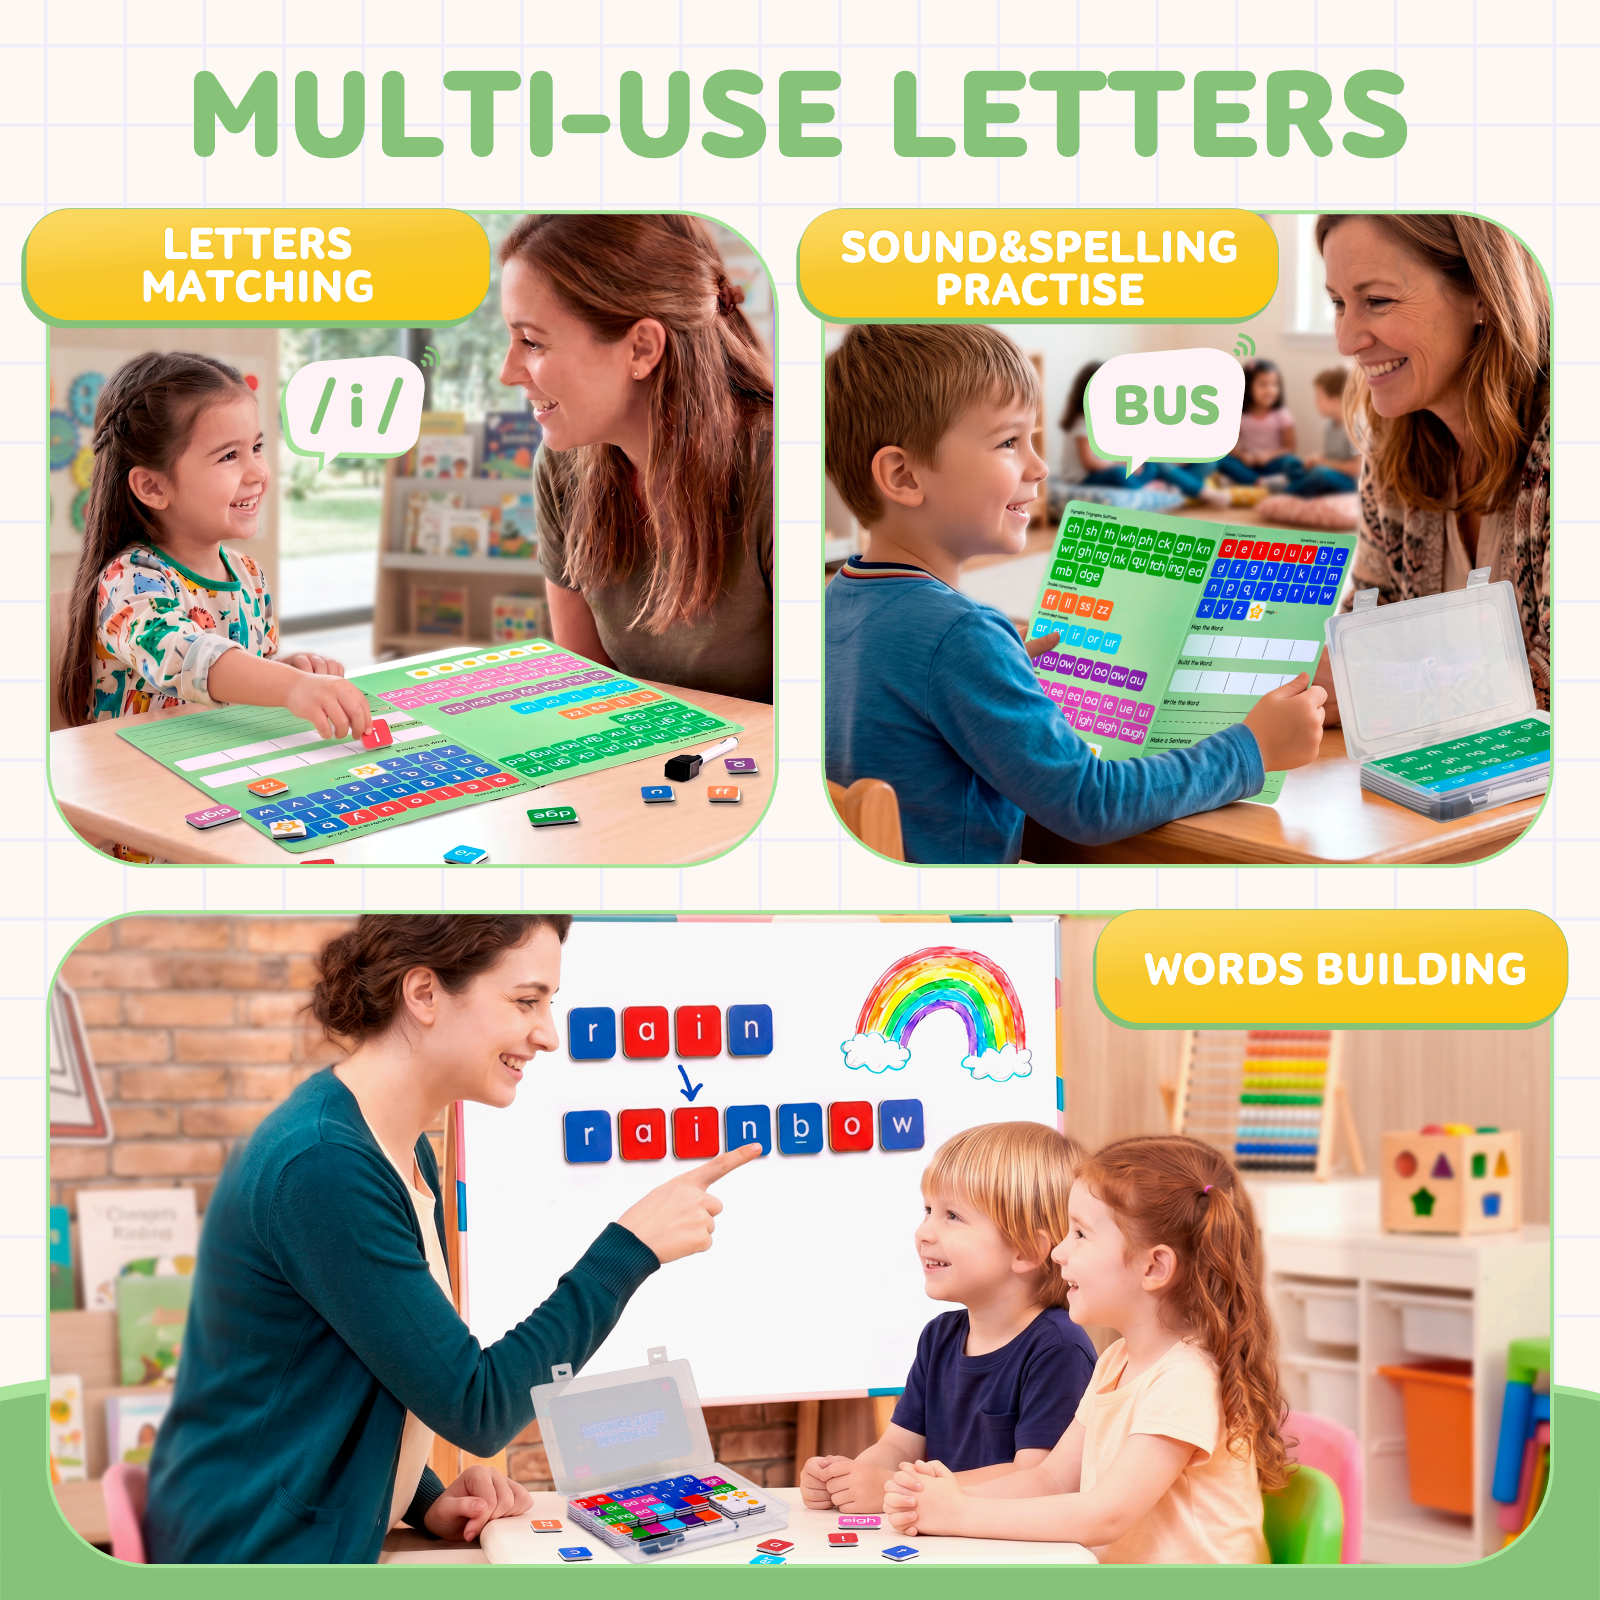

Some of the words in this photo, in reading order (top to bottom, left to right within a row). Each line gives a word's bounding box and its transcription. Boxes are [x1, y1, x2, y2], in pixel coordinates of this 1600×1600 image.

[1068, 522, 1080, 534] ch
[1085, 526, 1098, 536] sh
[1104, 528, 1115, 540] th
[1120, 532, 1136, 542] wh
[1138, 534, 1153, 547] ph
[1158, 538, 1171, 549] ck
[1176, 542, 1192, 553] gn
[1196, 542, 1210, 555] kn
[1061, 544, 1074, 554] wr
[1078, 547, 1092, 558] gh
[1095, 551, 1110, 563] ng
[1112, 554, 1126, 564] nk
[1132, 555, 1146, 569] qu
[1150, 559, 1165, 572] tch
[1168, 562, 1184, 577] ing
[1188, 567, 1204, 577] ed
[1259, 544, 1264, 554] i
[1304, 551, 1312, 562] y
[1320, 550, 1327, 560] b
[1056, 566, 1072, 576] mb
[1079, 568, 1100, 583] dge
[1218, 563, 1226, 572] d
[1235, 564, 1241, 573] f
[1250, 565, 1258, 576] g
[1266, 566, 1273, 576] h
[1283, 566, 1290, 579] j
[1298, 569, 1305, 578] k
[1226, 584, 1234, 595] p
[1244, 585, 1251, 596] q
[1294, 589, 1298, 597] t
[1046, 594, 1056, 605] ff
[1080, 602, 1091, 611] ss
[1097, 605, 1109, 615] zz
[1218, 604, 1228, 615] y
[1252, 608, 1260, 616] e
[1036, 624, 1048, 632] ar
[1072, 629, 1080, 640] ir
[1087, 635, 1100, 644] or
[1105, 639, 1117, 647] ur
[1043, 656, 1056, 668] ou
[1059, 659, 1074, 669] ow
[1077, 663, 1091, 676] oy
[1094, 667, 1108, 677] oo
[1110, 671, 1127, 682] aw
[1129, 676, 1144, 686] au
[1050, 688, 1064, 698] ee
[1067, 692, 1081, 702] ea
[1084, 696, 1099, 706] oa
[1103, 697, 1114, 710] ie
[1119, 704, 1133, 714] ue
[1138, 708, 1150, 718] ui
[1078, 714, 1093, 727] igh
[1096, 719, 1118, 734] eigh
[1121, 727, 1145, 740] augh
